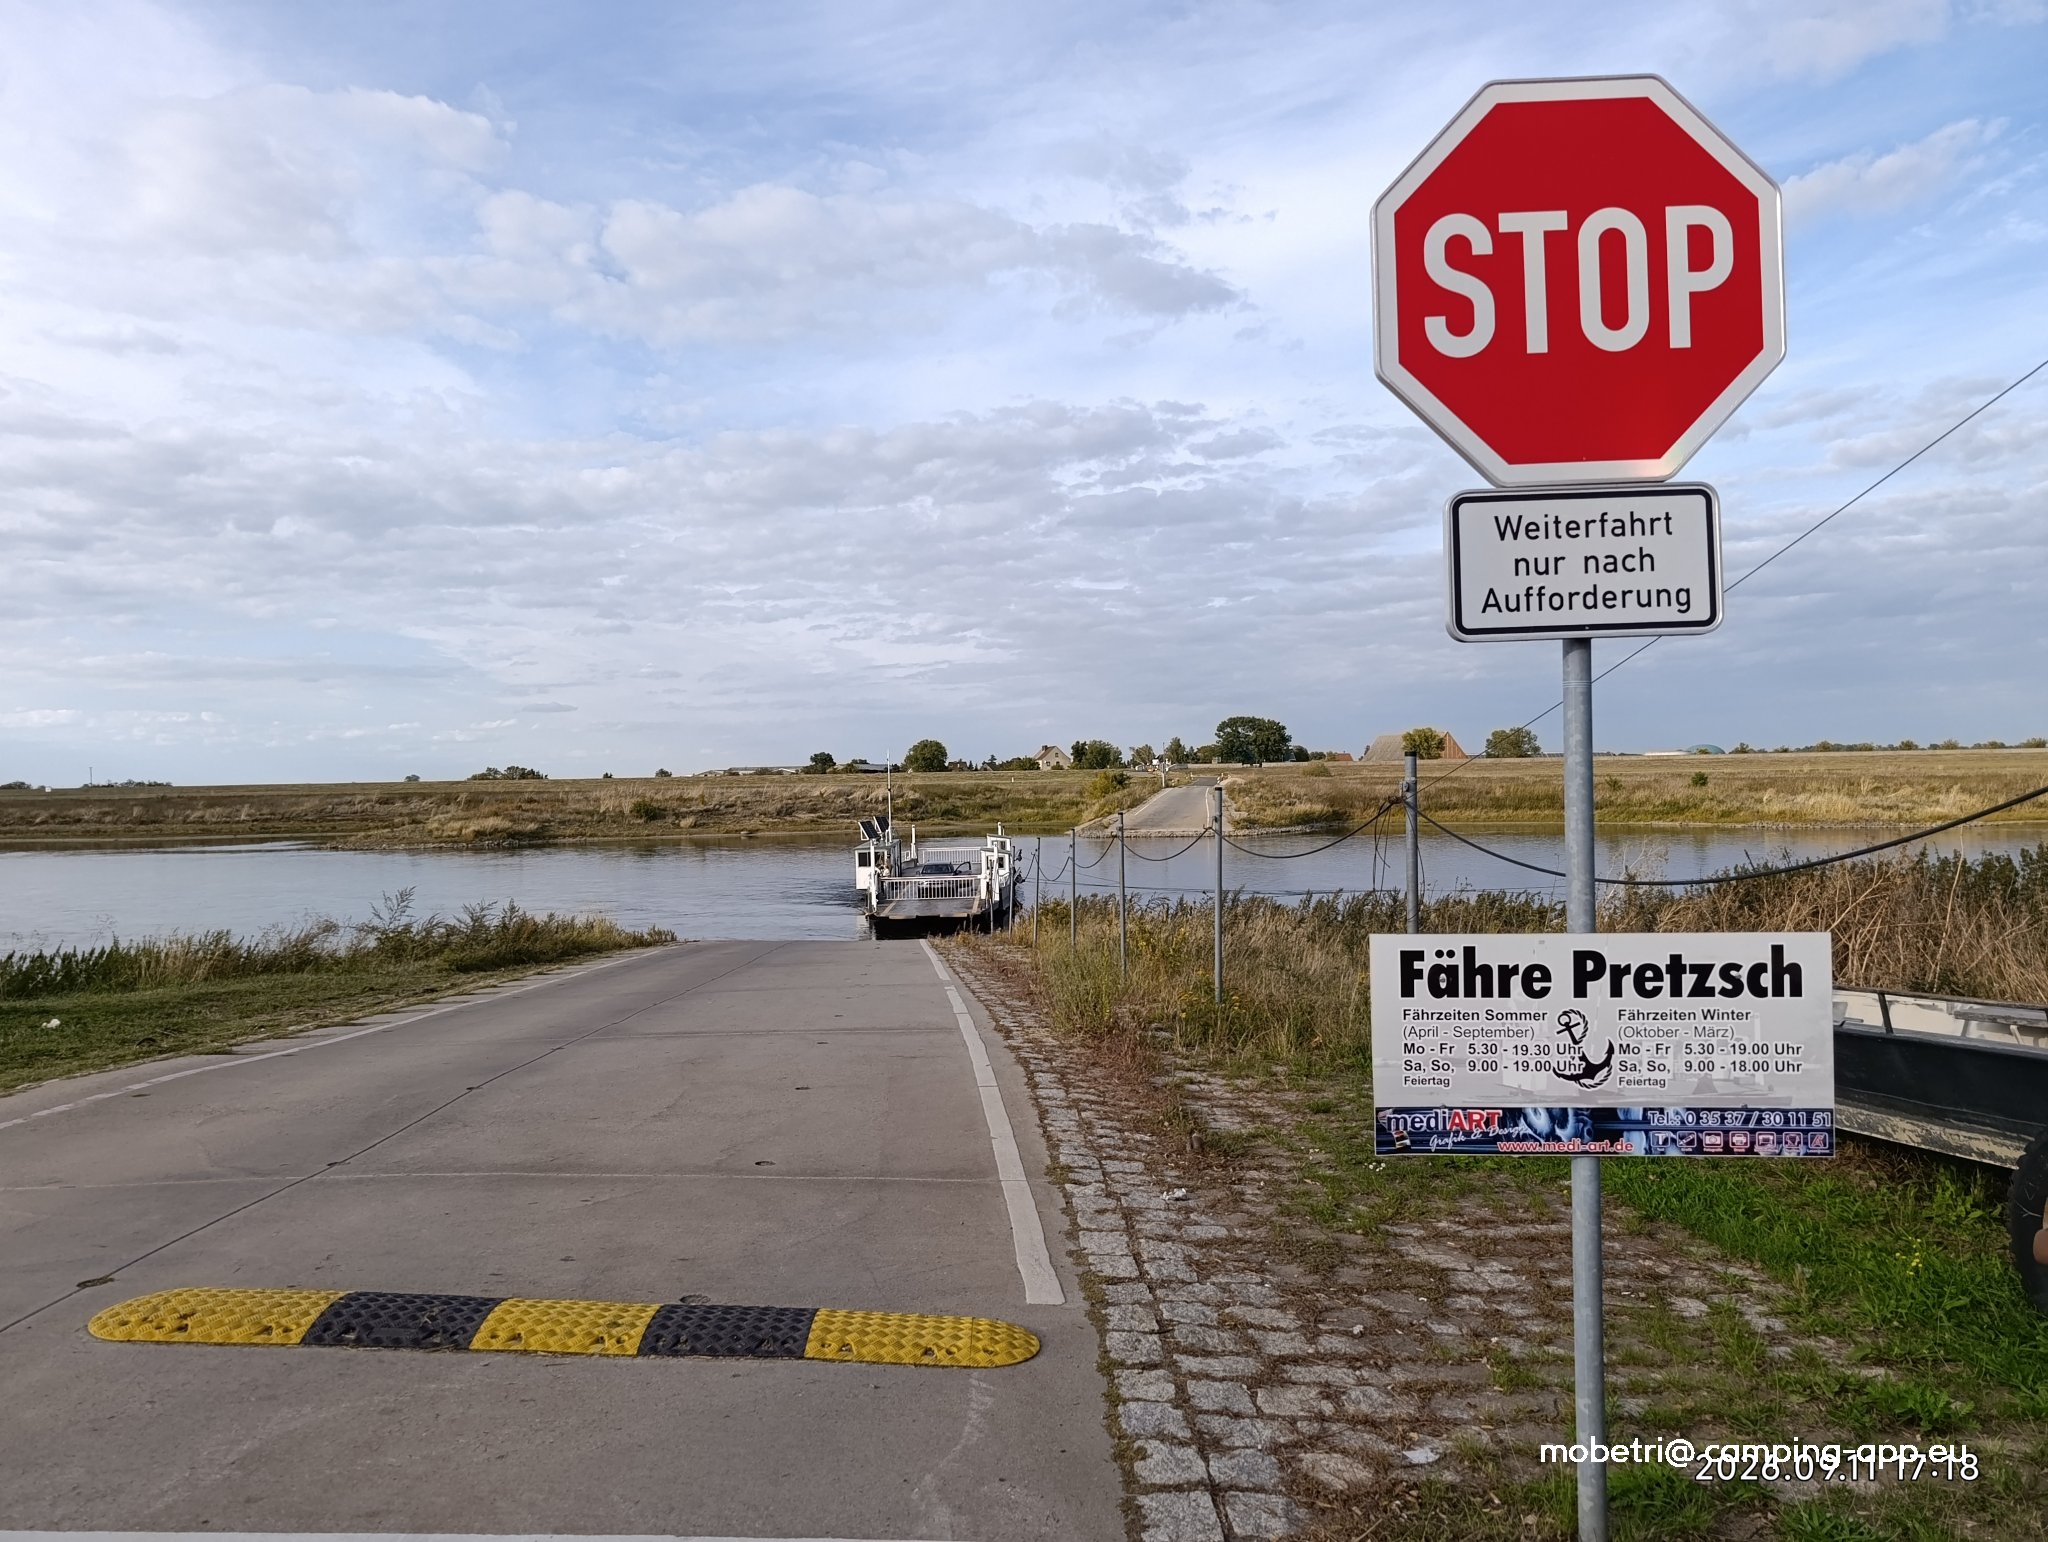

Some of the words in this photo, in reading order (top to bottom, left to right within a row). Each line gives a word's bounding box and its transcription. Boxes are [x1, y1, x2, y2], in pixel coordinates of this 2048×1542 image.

[1424, 205, 1734, 358] STOP
[1493, 510, 1673, 542] Weiterfahrt
[1514, 556, 1566, 577] nur
[1583, 546, 1655, 575] nach
[1481, 583, 1691, 614] Aufforderung
[1400, 946, 1552, 999] Fähre
[1573, 945, 1802, 998] Pretzsch
[1402, 1008, 1480, 1021] Fährzeiten
[1484, 1008, 1548, 1022] Sommer
[1618, 1008, 1697, 1022] Fährzeiten
[1701, 1008, 1752, 1021] Winter
[1402, 1025, 1440, 1040] (April
[1452, 1025, 1536, 1041] September)
[1617, 1025, 1680, 1041] (Oktober
[1693, 1025, 1735, 1041] März)
[1403, 1042, 1426, 1055] Mo
[1439, 1042, 1455, 1055] Fr
[1468, 1042, 1498, 1055] 5.30
[1513, 1044, 1551, 1057] 19.30
[1556, 1043, 1584, 1056] Uhr
[1618, 1043, 1641, 1055] Mo
[1655, 1042, 1671, 1055] Fr
[1684, 1042, 1715, 1055] 5.30
[1730, 1042, 1769, 1056] 19.00
[1774, 1043, 1802, 1056] Uhr
[1403, 1059, 1426, 1074] Sa,
[1431, 1059, 1455, 1074] So,
[1467, 1059, 1498, 1072] 9.00
[1514, 1060, 1551, 1073] 19.00
[1556, 1060, 1584, 1073] Uhr
[1618, 1059, 1642, 1074] Sa,
[1646, 1059, 1671, 1074] So,
[1684, 1060, 1715, 1072] 9.00
[1730, 1060, 1770, 1073] 18.00
[1774, 1060, 1803, 1073] Uhr
[1404, 1075, 1450, 1088] Feiertag
[1618, 1076, 1666, 1089] Feiertag
[1387, 1109, 1502, 1132] mediART
[1649, 1111, 1680, 1126] Tel.:
[1686, 1112, 1696, 1126] 0
[1700, 1111, 1721, 1126] 35
[1725, 1112, 1745, 1126] 37
[1749, 1111, 1758, 1127] /
[1762, 1112, 1783, 1126] 30
[1788, 1112, 1806, 1127] 11
[1812, 1112, 1831, 1127] 51
[1429, 1131, 1466, 1152] Grafik
[1498, 1138, 1634, 1152] www.medi-art.de
